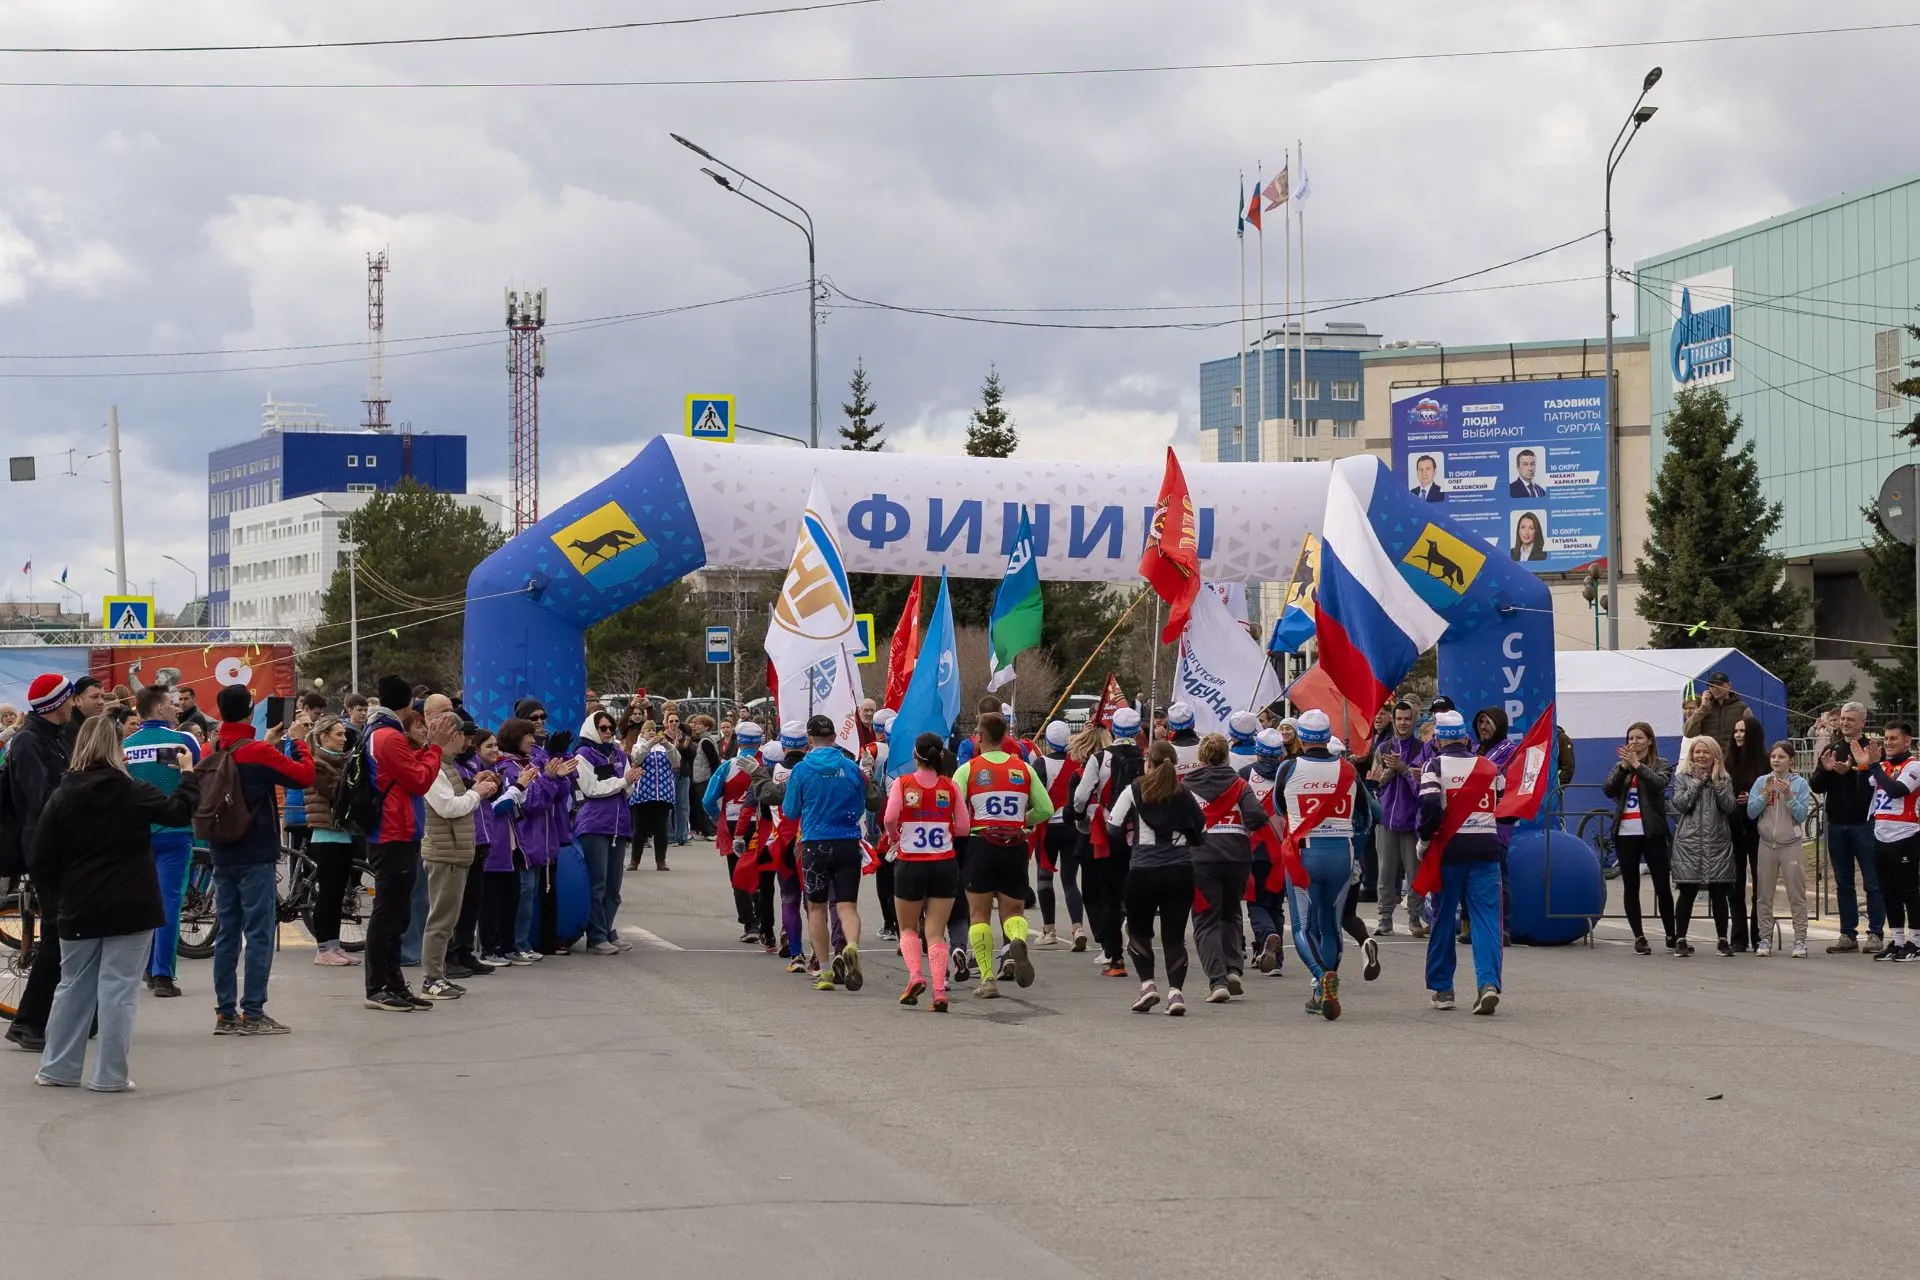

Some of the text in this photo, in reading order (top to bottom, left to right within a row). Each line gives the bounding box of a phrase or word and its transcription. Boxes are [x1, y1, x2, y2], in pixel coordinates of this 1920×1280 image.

[1691, 340, 1728, 363] ТРАНСГАЗ
[1544, 397, 1600, 409] ГАЗОВИКИ
[1462, 416, 1497, 427] ЛЮДИ
[1544, 410, 1601, 421] ПАТРИОТЫ
[1462, 427, 1525, 439] ВЫБИРАЮТ
[1556, 423, 1601, 434] СУРГУТА
[1558, 463, 1580, 471] ОКРУГ
[847, 493, 1215, 560] ФИНИ
[126, 747, 159, 760] СУРГ
[1302, 782, 1319, 790] СК
[1451, 776, 1465, 784] СК
[985, 796, 1019, 816] 65
[912, 826, 945, 849] 36
